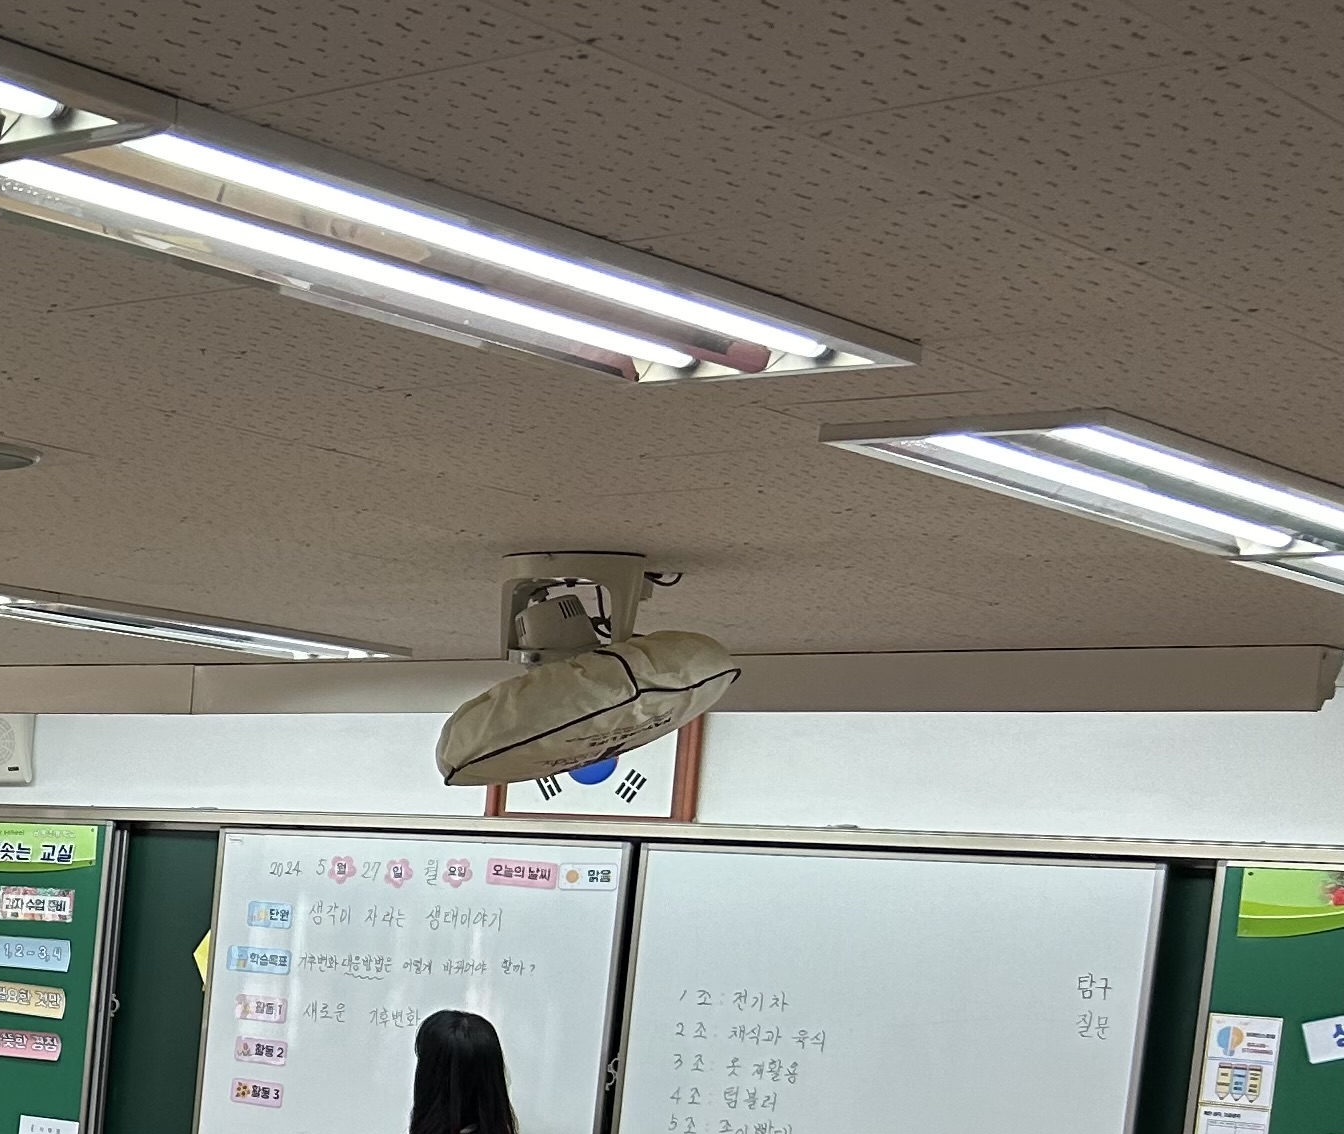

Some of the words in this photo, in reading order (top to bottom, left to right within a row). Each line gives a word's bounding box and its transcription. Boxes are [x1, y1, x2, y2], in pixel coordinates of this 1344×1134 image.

[40, 843, 73, 863] 교실
[269, 860, 303, 878] 2024
[316, 858, 327, 876] 5
[336, 862, 347, 875] 월
[361, 861, 381, 881] 27
[392, 866, 403, 879] 일
[424, 859, 439, 886] 월
[448, 866, 467, 878] 요일
[492, 864, 525, 879] 오늘의
[527, 867, 551, 882] 날씨
[587, 869, 612, 883] 맑음
[25, 898, 45, 912] 수업
[269, 908, 290, 922] 단원
[309, 900, 351, 926] 생각이
[364, 904, 405, 928] 자라는
[425, 904, 503, 932] 생태이야기
[249, 952, 288, 968] 학습목표
[1077, 971, 1113, 1001] 탐구
[35, 990, 62, 1009] 것만
[255, 1000, 275, 1015] 활동
[732, 988, 789, 1012] 전기차
[302, 1001, 346, 1023] 새로운
[1075, 1009, 1110, 1040] 질문
[31, 1034, 59, 1052] 경청
[728, 1023, 782, 1045] 채식과
[792, 1029, 826, 1052] 육식
[254, 1043, 274, 1058] 활동
[276, 1047, 284, 1058] 2
[726, 1056, 742, 1077] 옷
[752, 1058, 799, 1084] 재활용
[251, 1084, 270, 1100] 활동
[272, 1088, 280, 1100] 3
[723, 1086, 777, 1112] 텀블러
